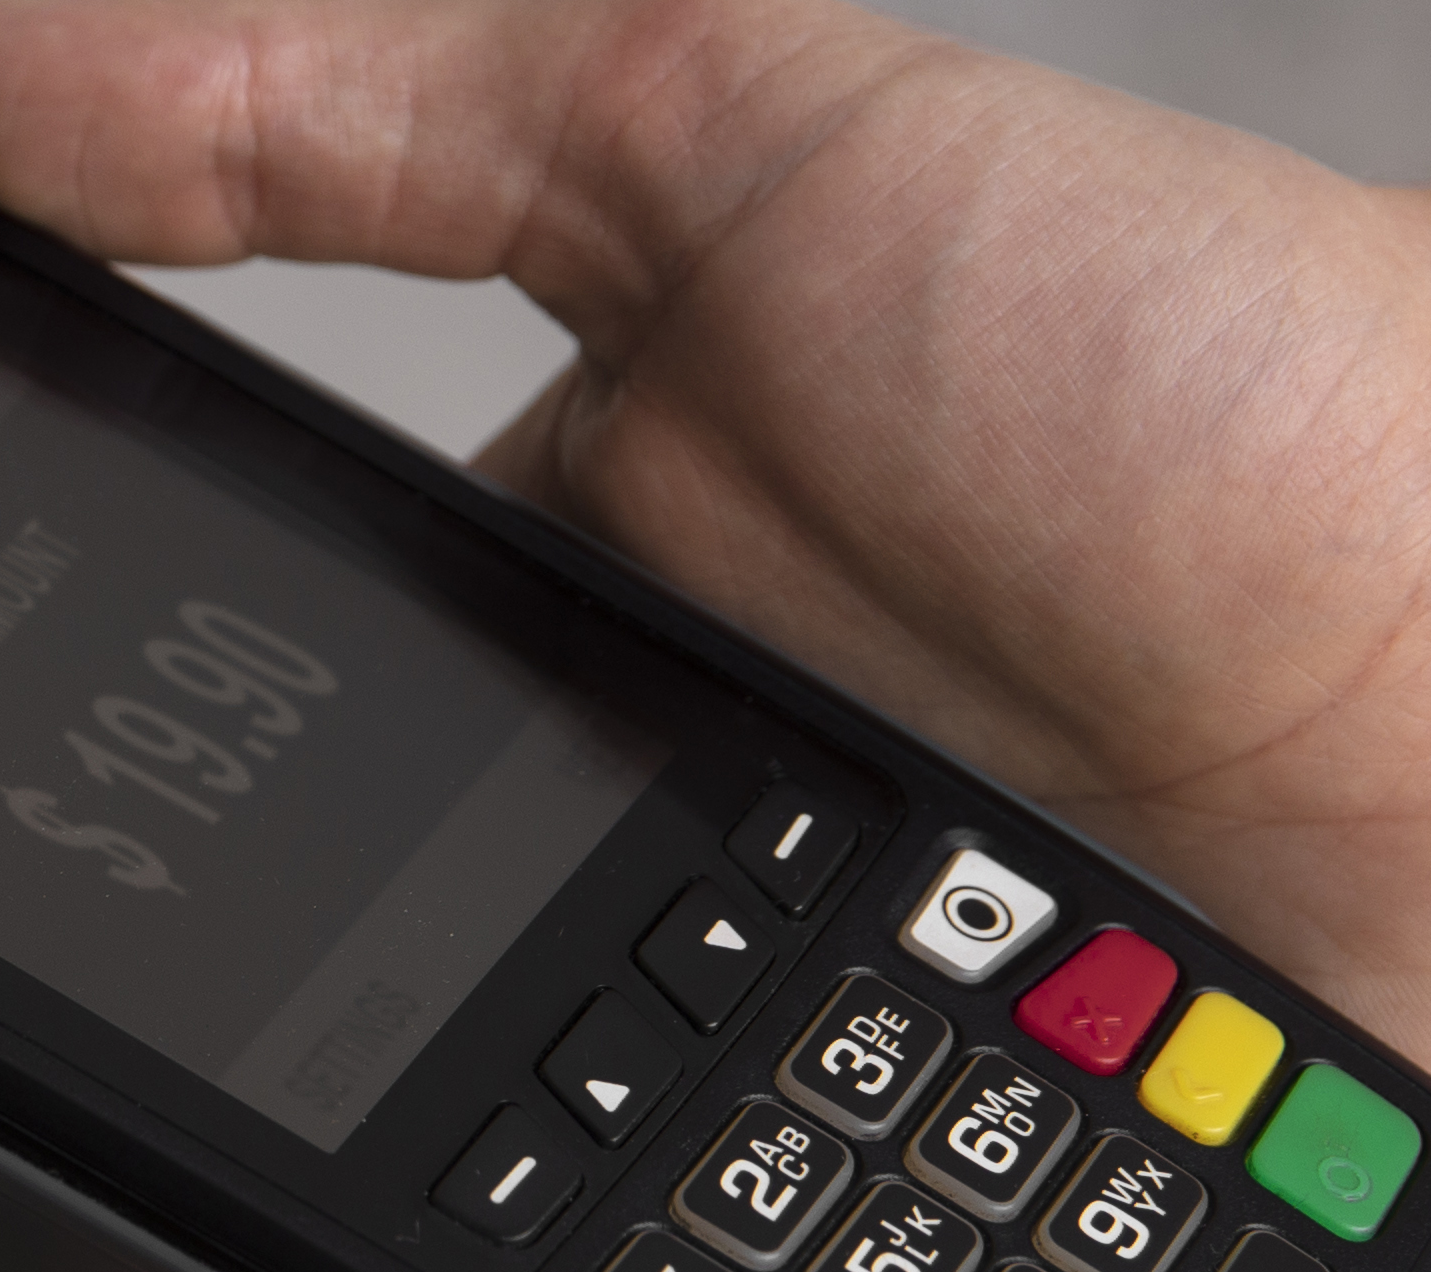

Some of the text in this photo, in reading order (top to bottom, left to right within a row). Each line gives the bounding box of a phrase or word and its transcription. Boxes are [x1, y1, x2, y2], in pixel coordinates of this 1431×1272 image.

[0, 600, 339, 896] $ 19.90
[280, 979, 422, 1113] SETTINGS
[821, 1038, 895, 1095] 3
[948, 1116, 1019, 1174] 6
[720, 1159, 798, 1222] 2
[1079, 1200, 1150, 1260] 9
